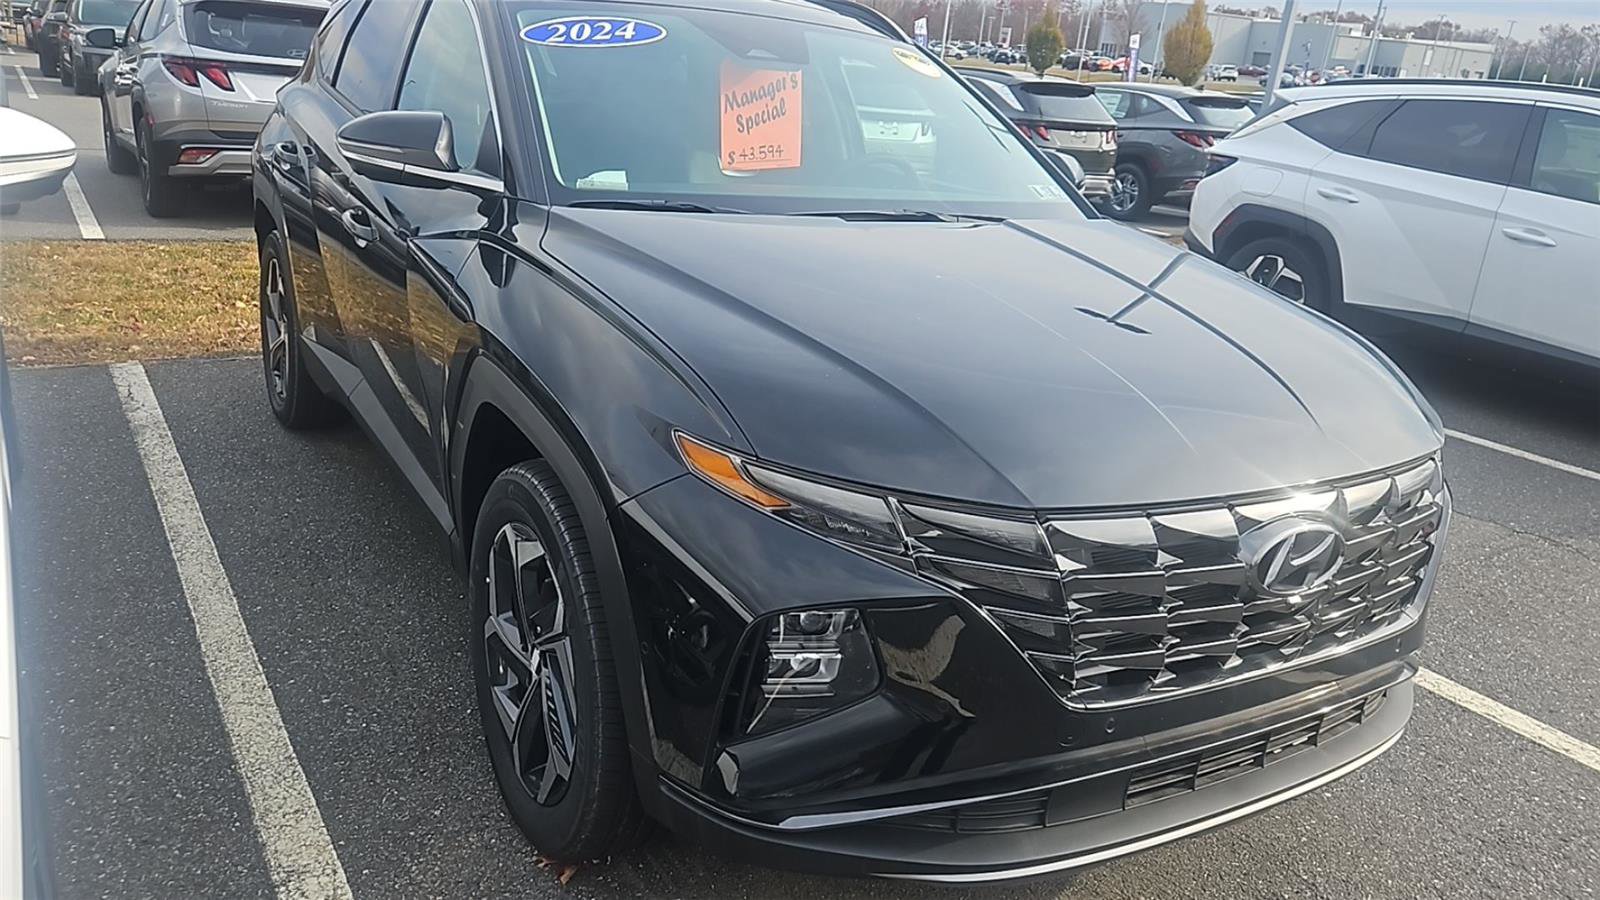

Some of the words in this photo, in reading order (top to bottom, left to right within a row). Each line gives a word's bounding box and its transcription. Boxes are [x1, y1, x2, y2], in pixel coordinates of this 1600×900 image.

[545, 21, 636, 43] 2024
[724, 72, 799, 113] Manager's
[736, 97, 787, 135] Special
